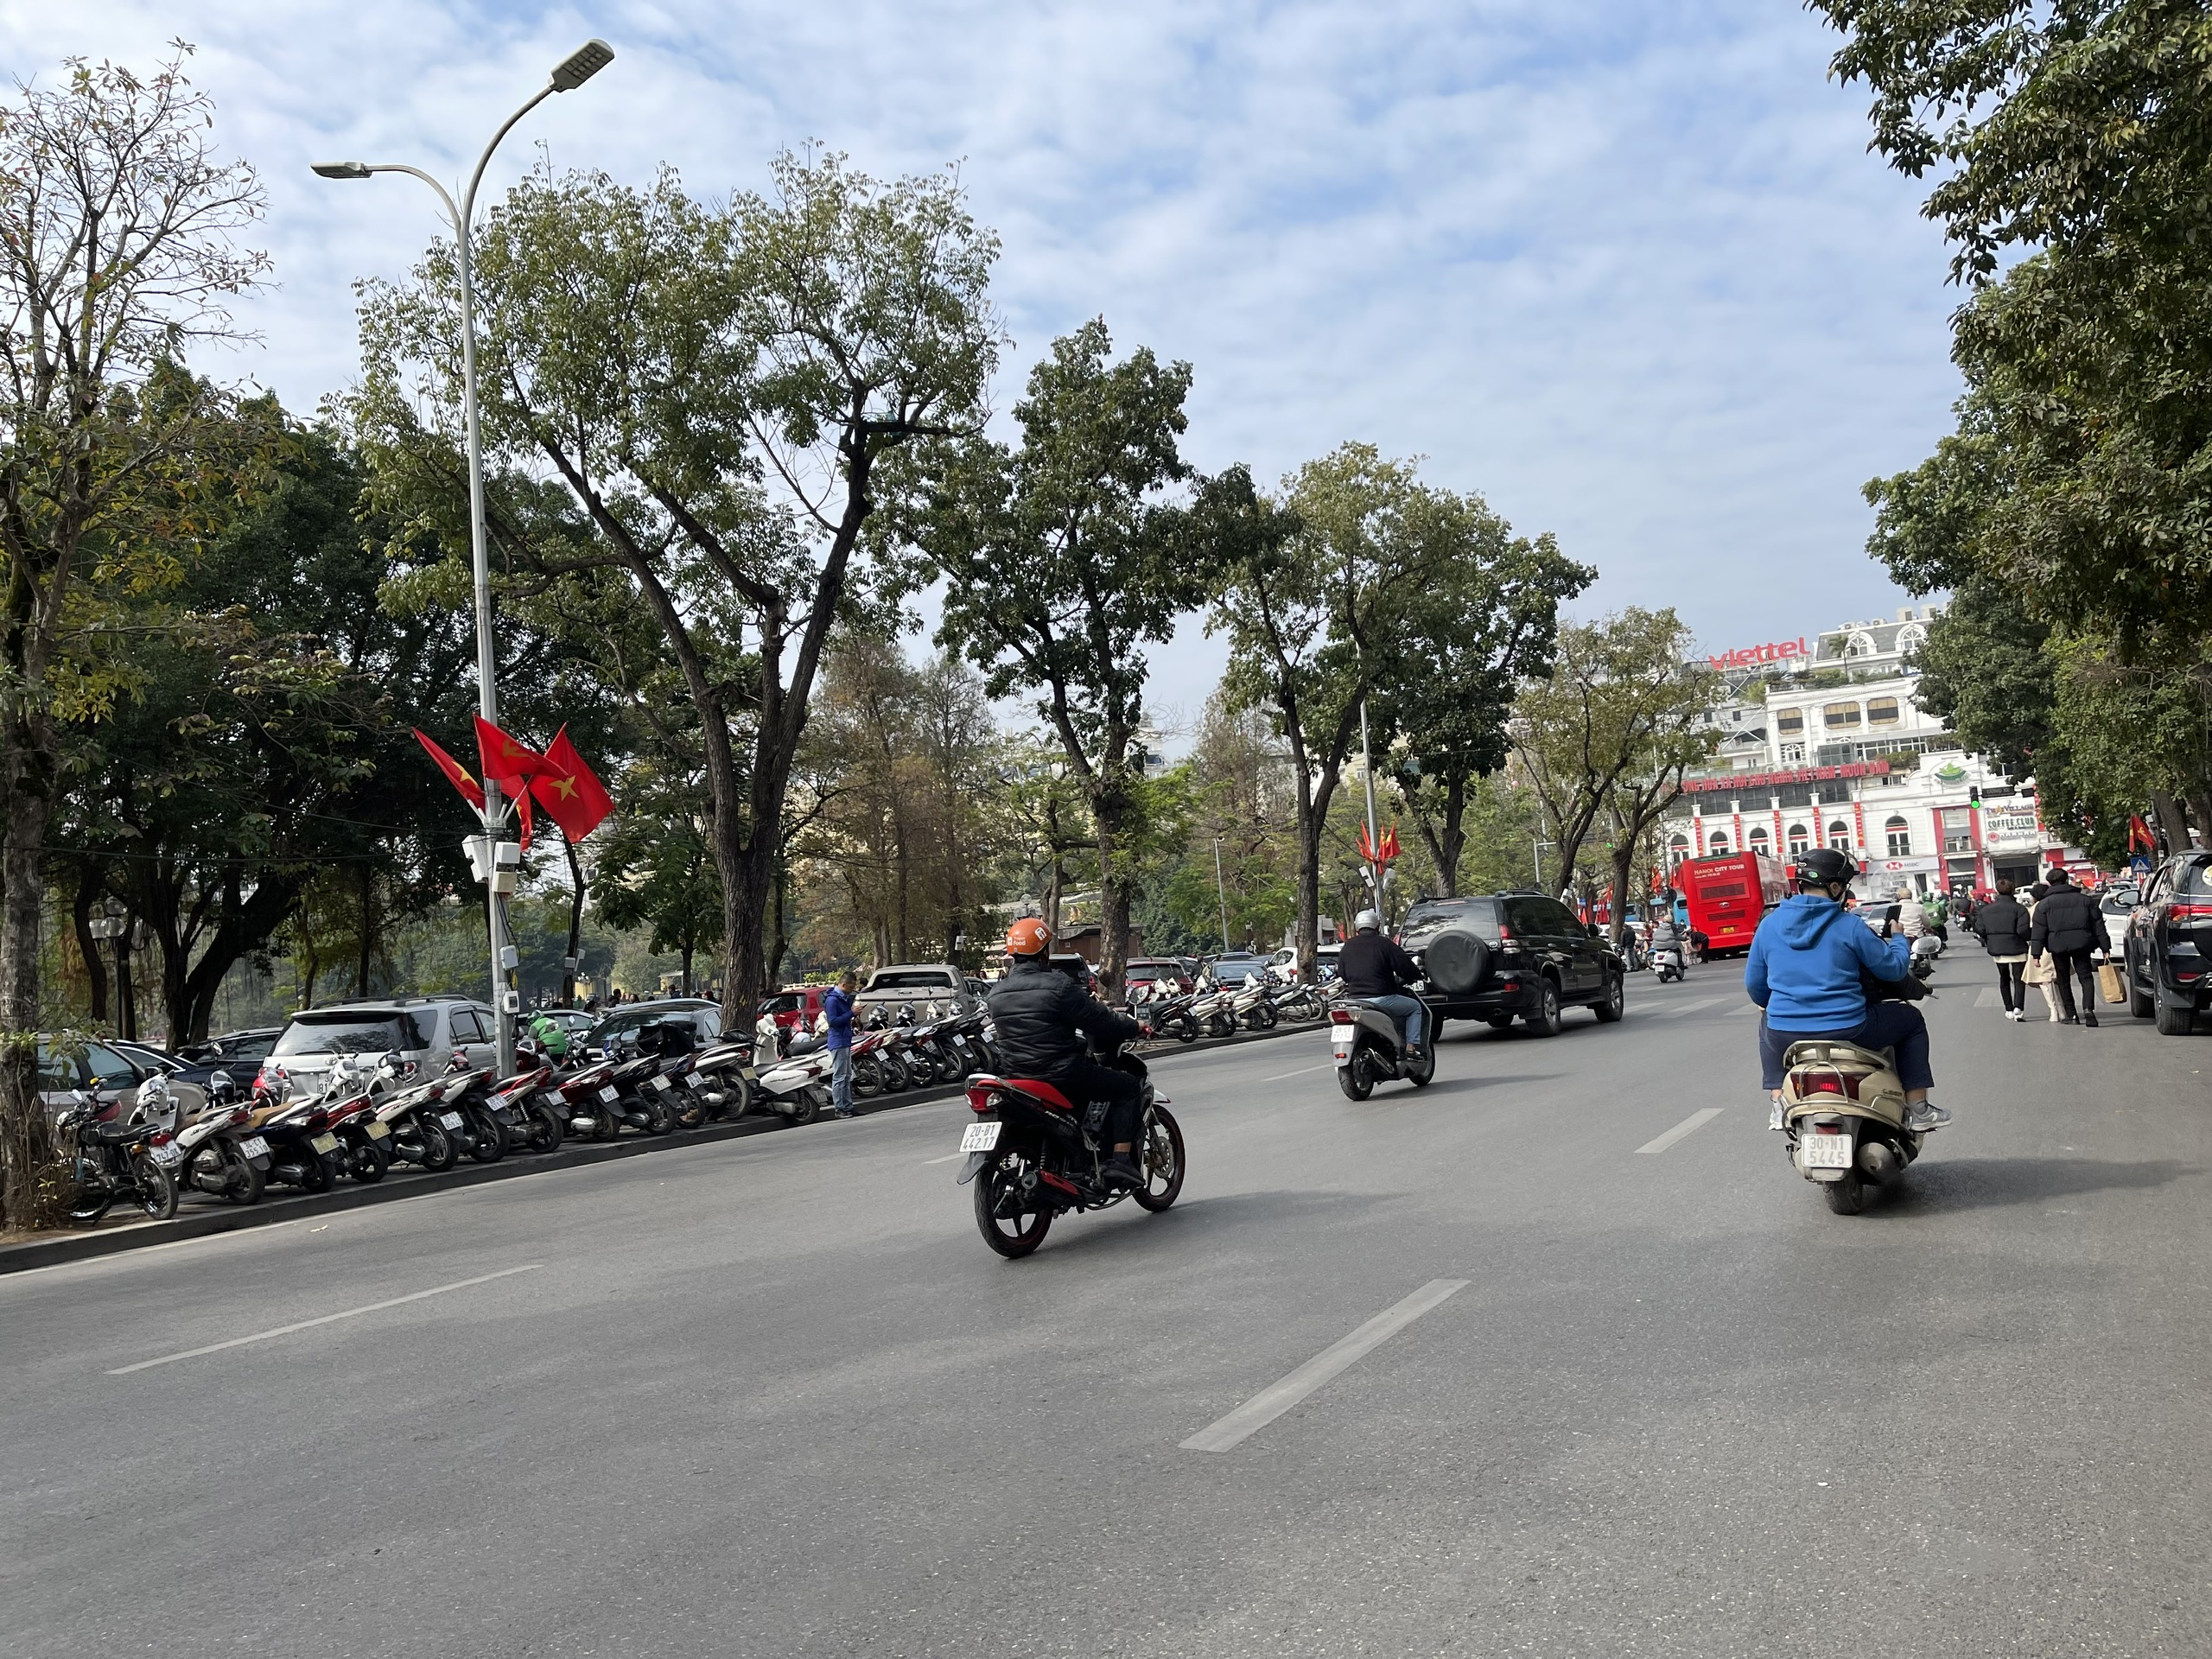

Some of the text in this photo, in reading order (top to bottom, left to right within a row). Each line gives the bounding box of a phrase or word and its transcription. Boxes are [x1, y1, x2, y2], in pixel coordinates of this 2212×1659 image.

[1708, 637, 1810, 670] viettel
[1988, 818, 2014, 829] COFFEE
[969, 1124, 995, 1137] 20-B1
[243, 1138, 262, 1150] 34-C1
[1809, 1137, 1844, 1149] 30-N1
[1809, 1151, 1845, 1165] 5445
